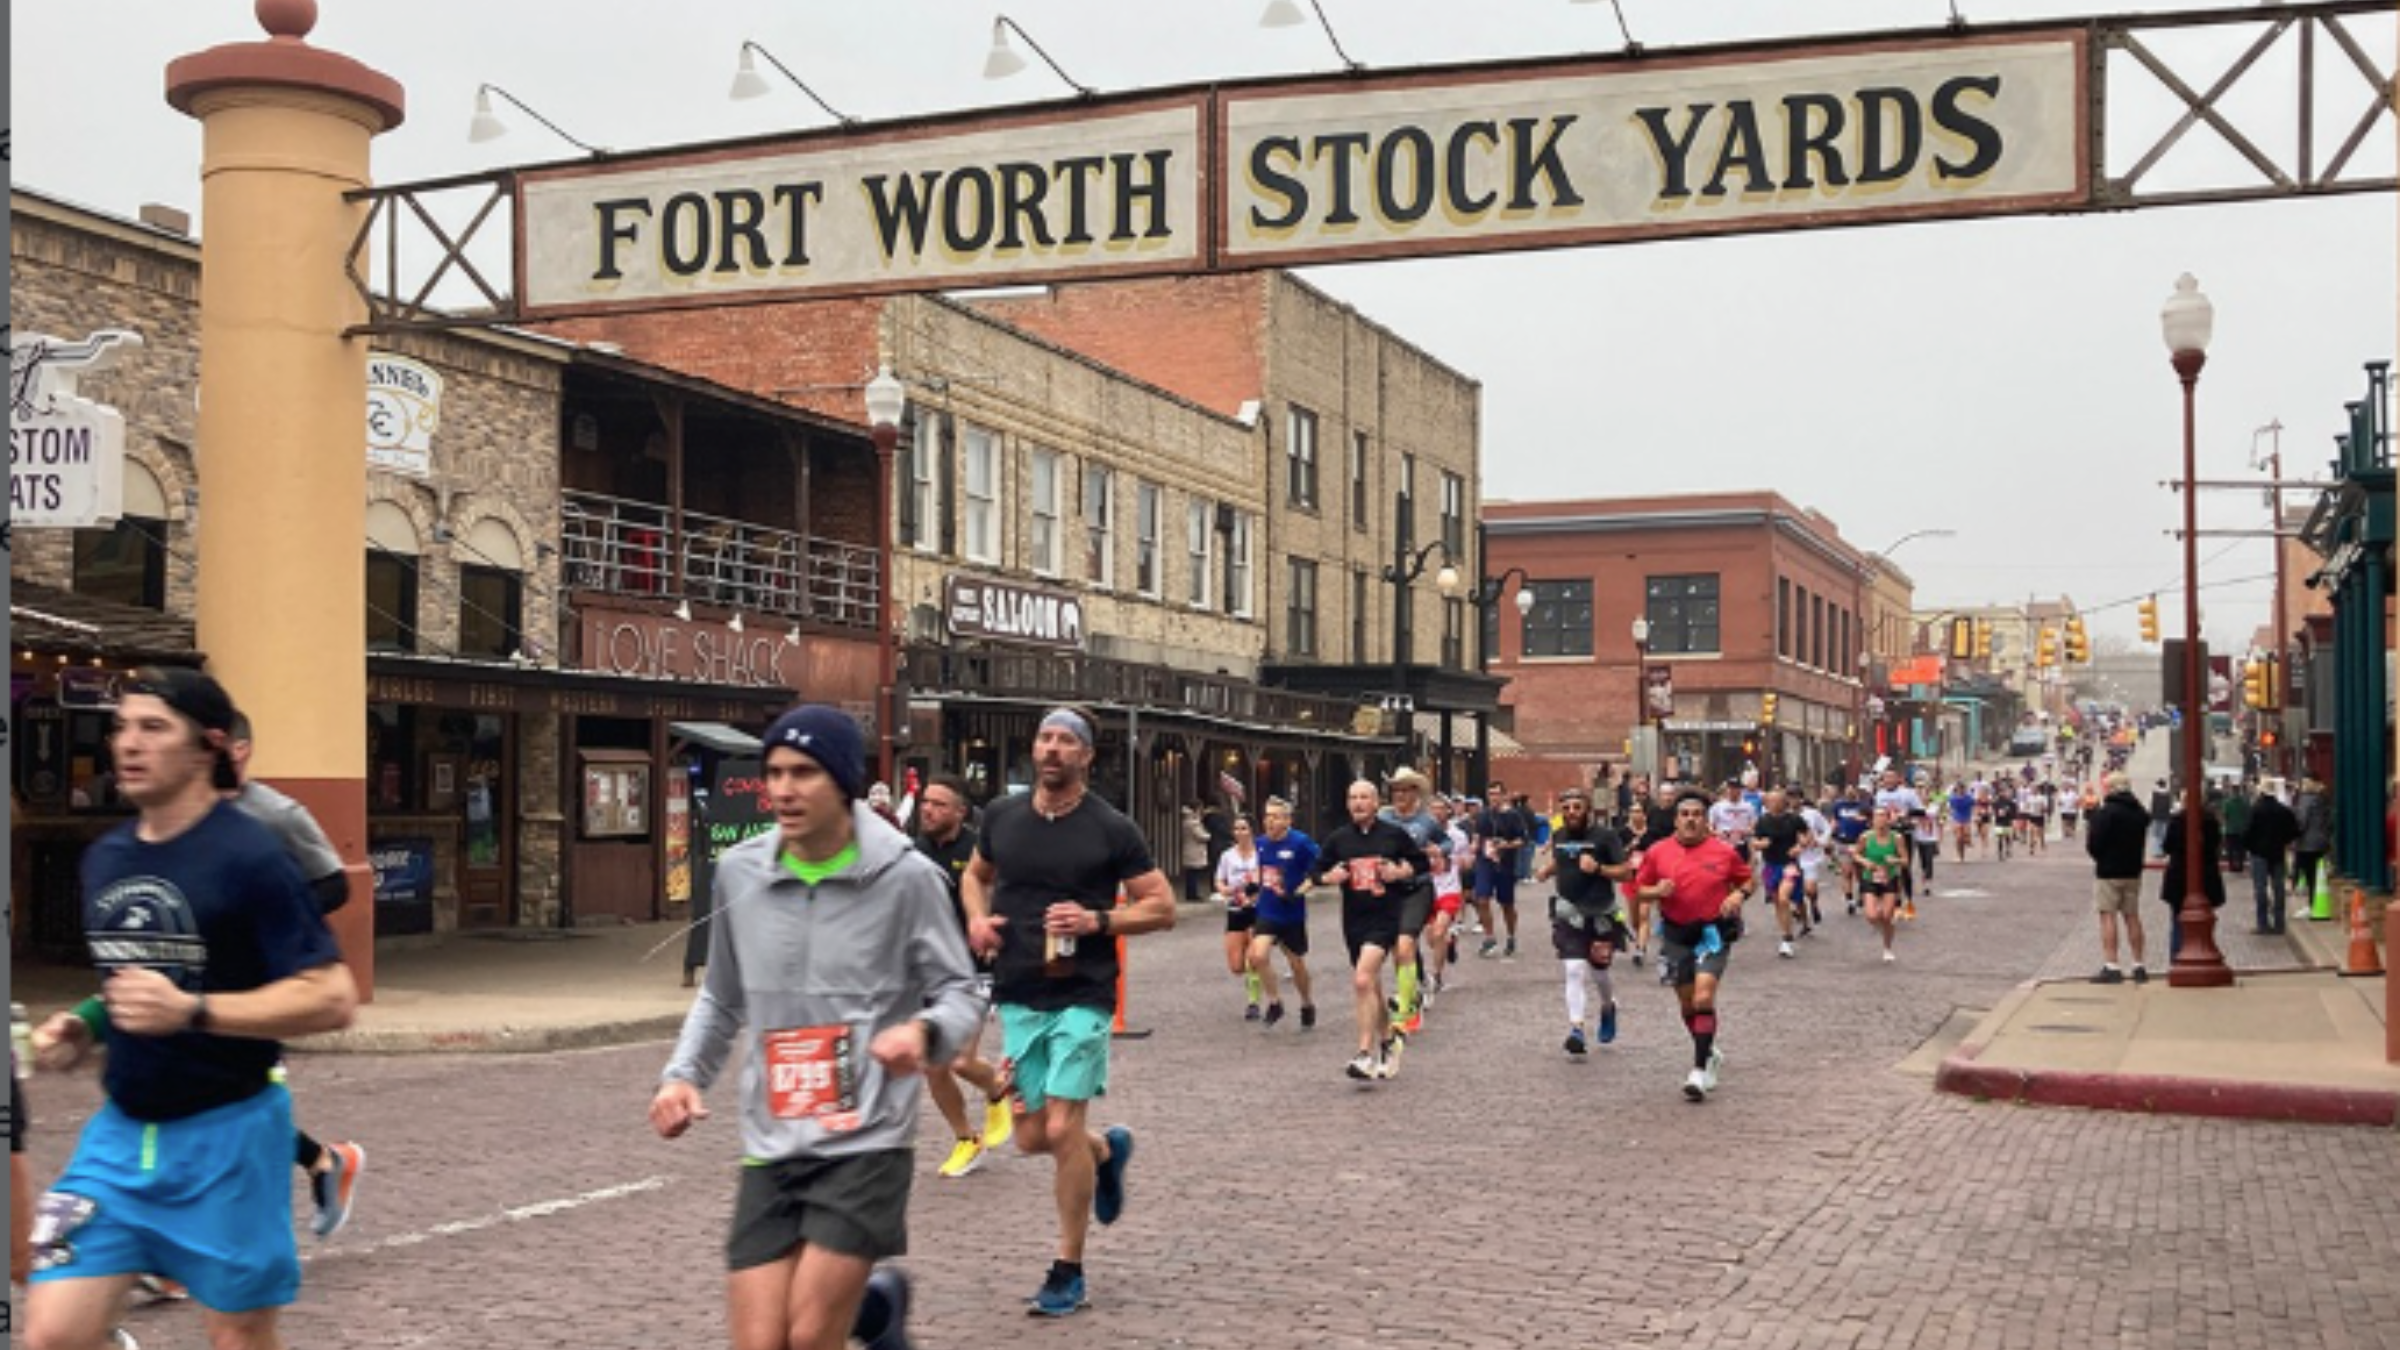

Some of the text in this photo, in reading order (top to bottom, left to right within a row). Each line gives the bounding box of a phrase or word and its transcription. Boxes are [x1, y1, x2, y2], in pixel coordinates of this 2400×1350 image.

[592, 75, 2003, 281] FORT WORTH STOCK YARDS
[10, 427, 90, 465] STOM
[10, 473, 61, 510] ATS
[982, 586, 1059, 640] SALOON
[693, 630, 787, 687] SHACK
